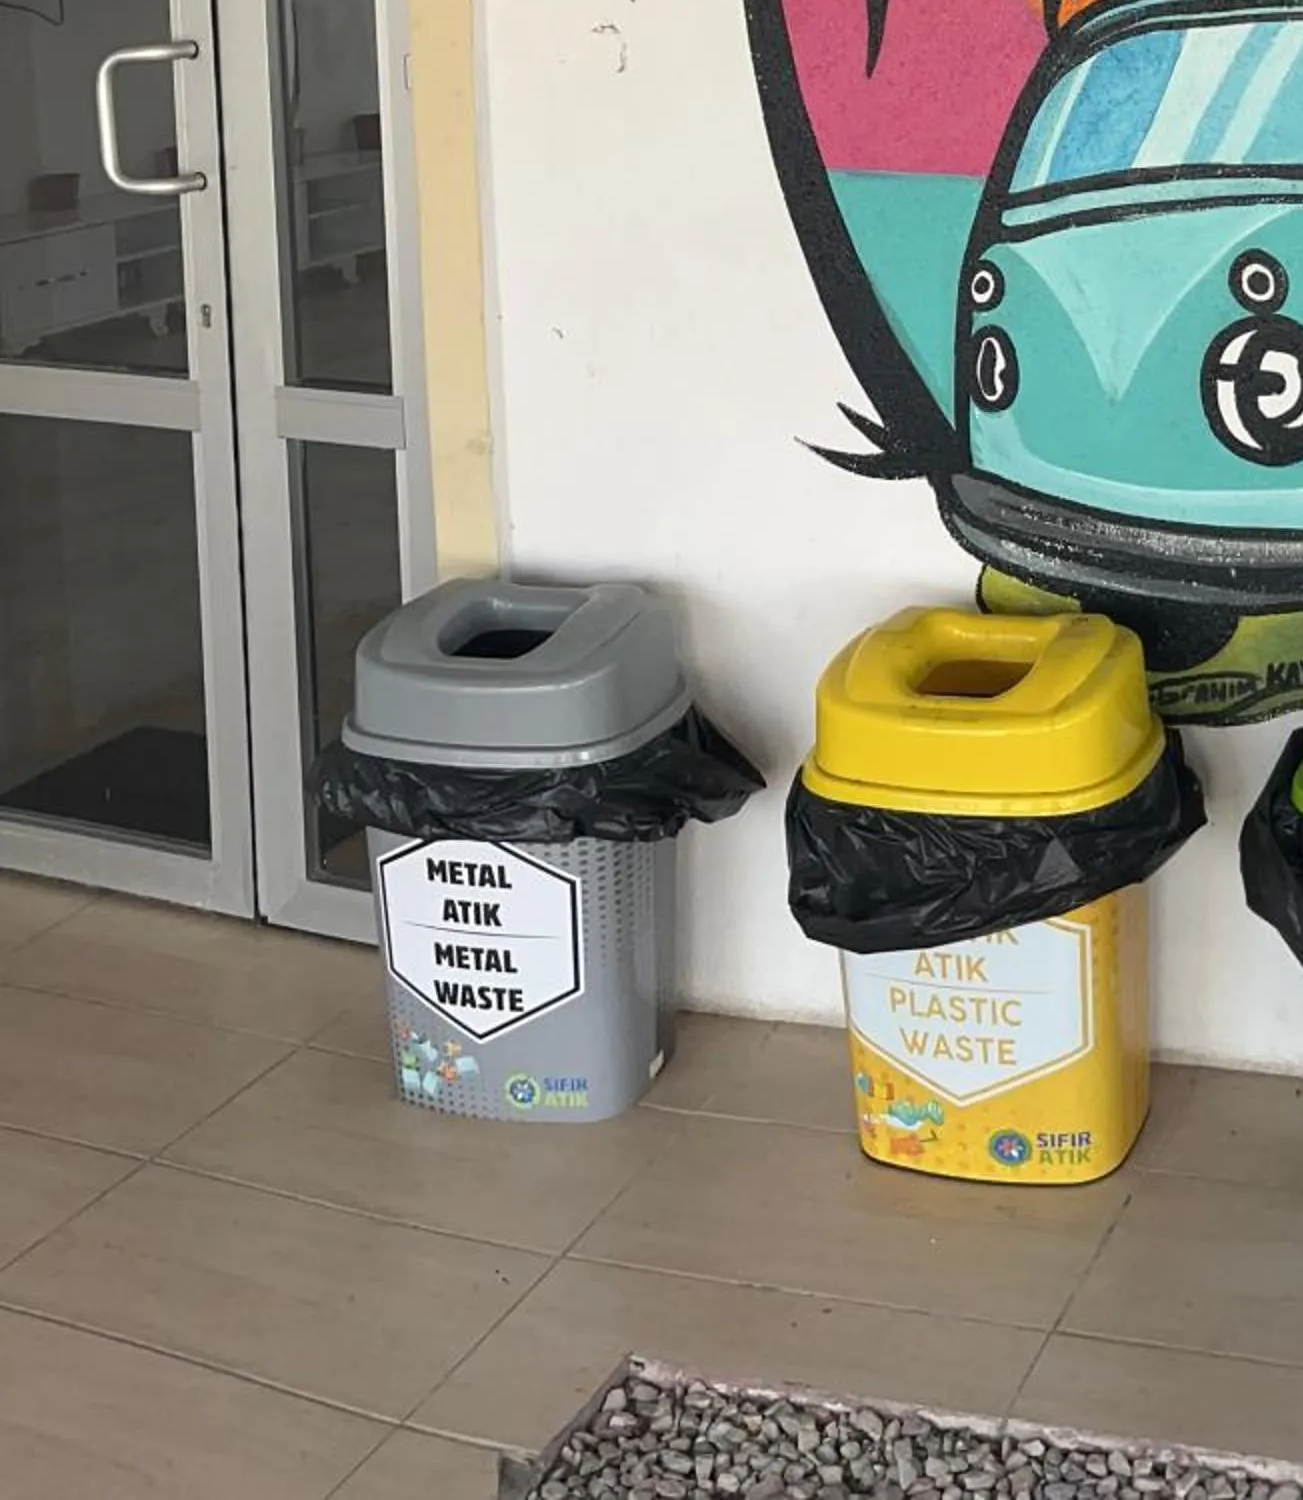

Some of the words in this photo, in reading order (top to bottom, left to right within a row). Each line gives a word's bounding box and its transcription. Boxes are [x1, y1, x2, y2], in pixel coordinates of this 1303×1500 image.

[426, 857, 512, 889] METAL
[442, 899, 502, 927] ATIK
[434, 942, 518, 974] METAL
[914, 951, 989, 983] ATIK
[434, 980, 525, 1013] WASTE
[889, 986, 1023, 1027] PLASTIC
[899, 1027, 1018, 1066] WASTE
[543, 1092, 589, 1108] ATIK
[1036, 1131, 1092, 1149] SIFIR
[1038, 1148, 1092, 1165] ATIK
